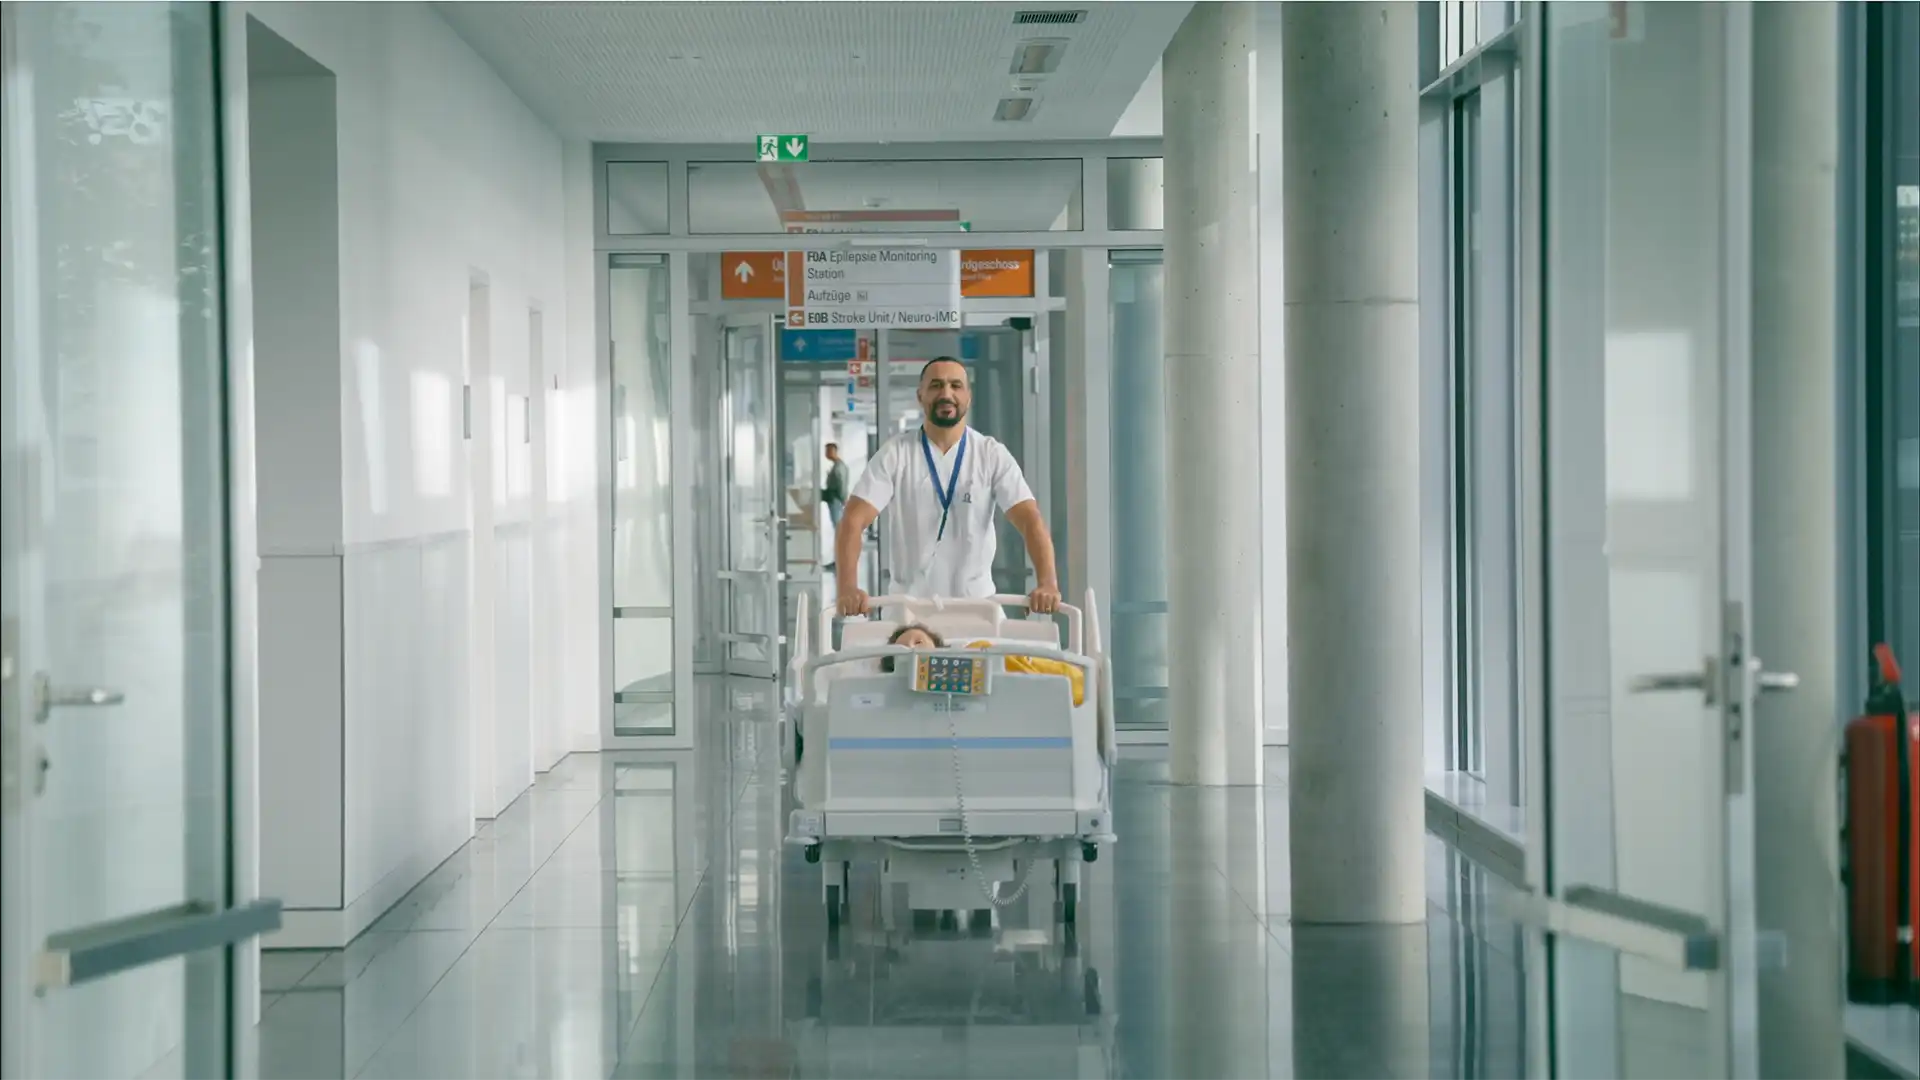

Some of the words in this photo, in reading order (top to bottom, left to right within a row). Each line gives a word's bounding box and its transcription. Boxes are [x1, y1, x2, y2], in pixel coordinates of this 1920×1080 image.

[830, 250, 876, 264] Epilepsie
[880, 250, 937, 264] Monitoring
[961, 258, 1020, 272] rdgeschoss
[807, 267, 844, 279] Station
[808, 289, 851, 303] Aufzüge
[832, 311, 865, 323] Stroke
[898, 310, 958, 323] Neuro-IMC
